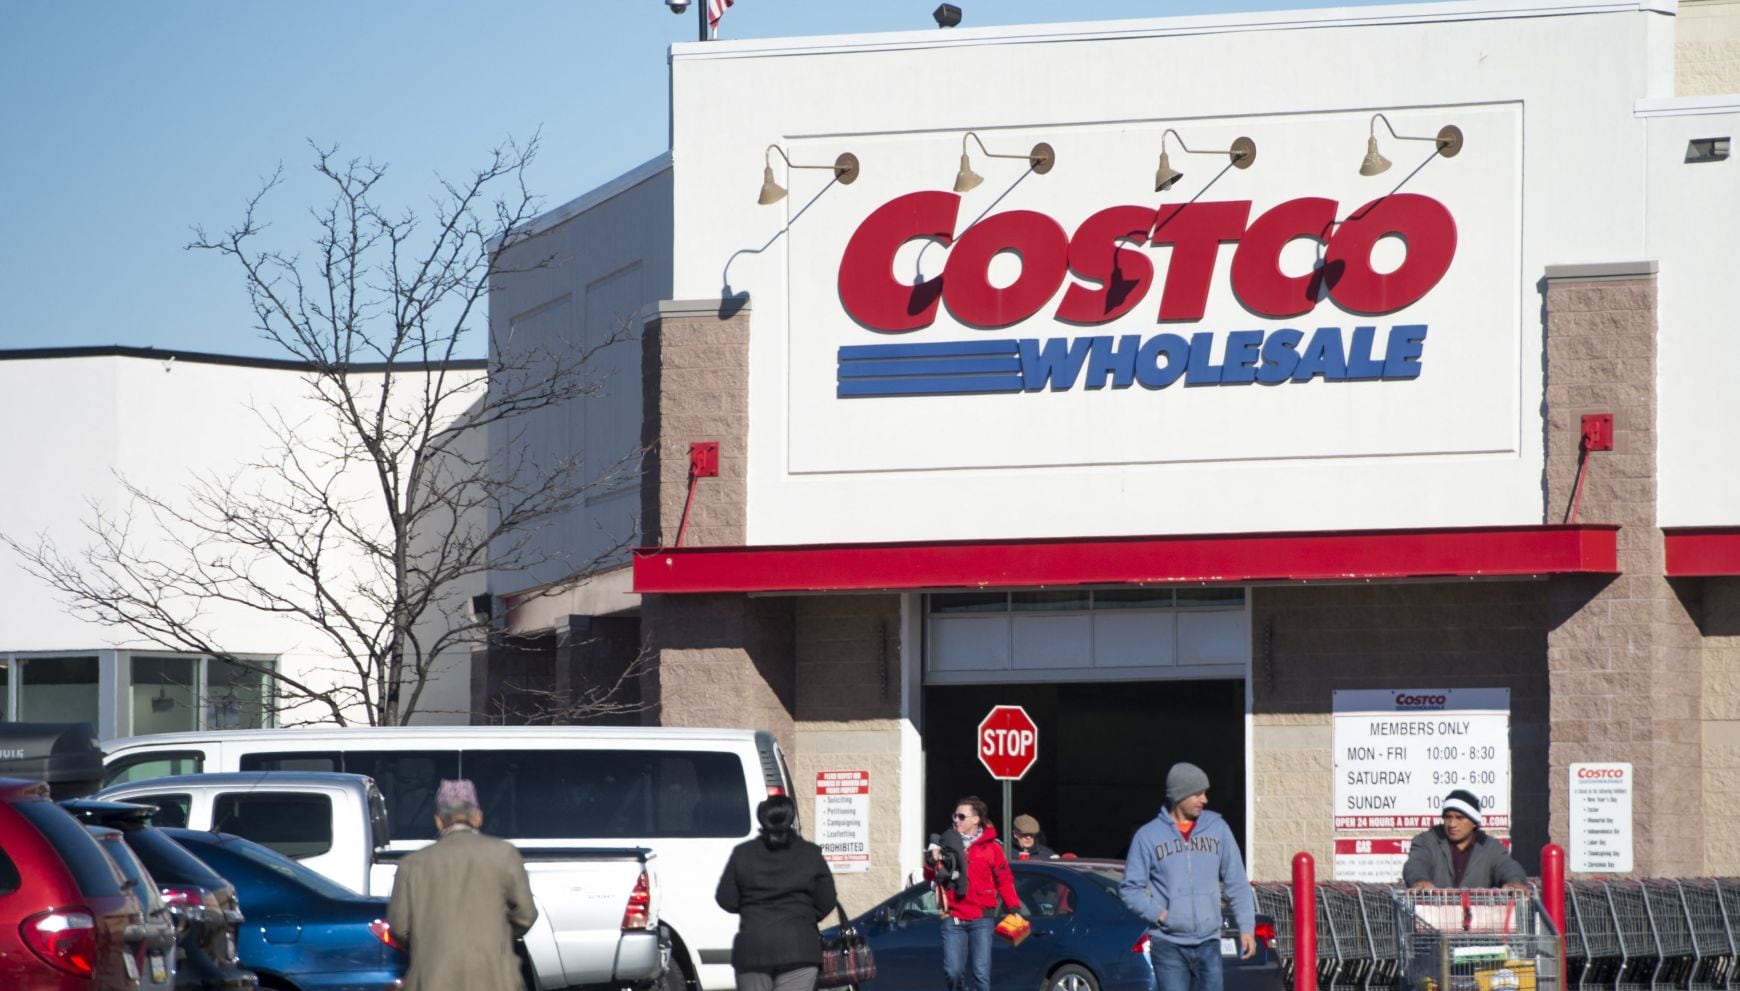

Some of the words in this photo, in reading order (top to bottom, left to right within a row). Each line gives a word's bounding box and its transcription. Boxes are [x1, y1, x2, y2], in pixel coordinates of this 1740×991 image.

[837, 190, 1458, 334] COSTCO
[1018, 324, 1428, 393] WHOLESALE
[1396, 693, 1446, 706] COSTCO
[1370, 722, 1434, 736] MEMBERS
[1438, 721, 1470, 735] ONLY
[983, 729, 1033, 756] STOP
[1347, 747, 1375, 761] MON
[1387, 747, 1407, 760] FRI
[1427, 746, 1457, 760] 10:00
[1469, 746, 1495, 760] 8:30
[1347, 771, 1411, 785] SATURDAY
[1433, 771, 1458, 784] 9:30
[1469, 770, 1495, 784] 6:00
[1577, 768, 1623, 779] COSTCO
[827, 796, 852, 804] Soliciting
[1347, 795, 1397, 809] SUNDAY
[1427, 796, 1445, 809] 10:
[827, 808, 856, 816] Petitioning
[827, 819, 860, 827] Campaigning
[1335, 817, 1356, 827] OPEN
[1357, 817, 1367, 827] 24
[1369, 817, 1395, 827] HOURS
[1397, 817, 1403, 827] A
[1404, 817, 1419, 827] DAY
[1421, 817, 1431, 827] AT
[820, 842, 864, 852] PROHIBITED
[1155, 838, 1183, 861] OLD
[1190, 836, 1220, 855] NAVY
[1355, 840, 1372, 853] GAS
